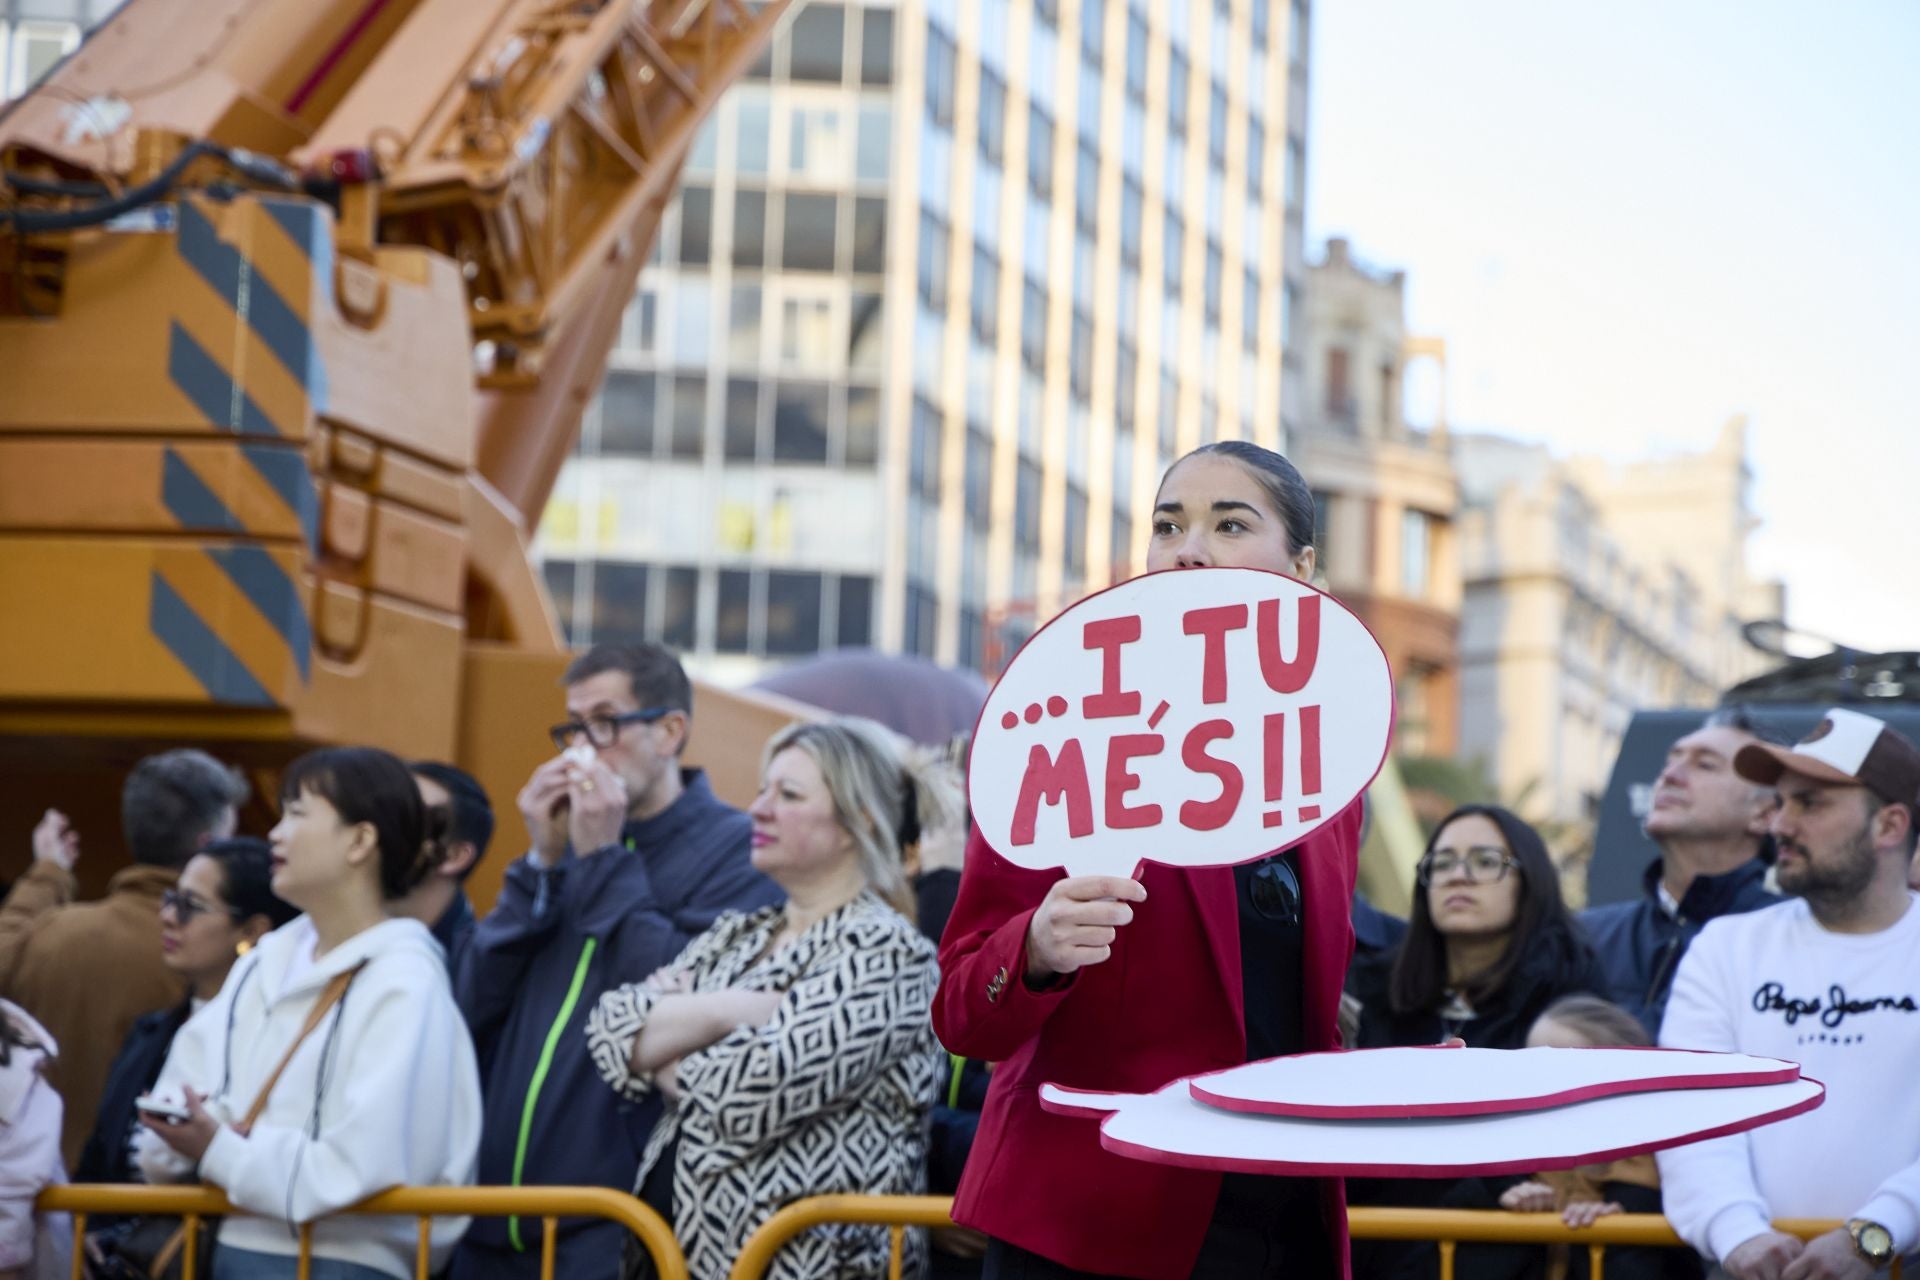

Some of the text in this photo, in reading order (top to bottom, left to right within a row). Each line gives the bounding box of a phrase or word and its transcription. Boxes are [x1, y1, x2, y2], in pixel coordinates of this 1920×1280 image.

[1182, 594, 1321, 705] TU
[1010, 699, 1322, 847] MÉS!!
[1753, 982, 1918, 1028] Pepe Jeans
